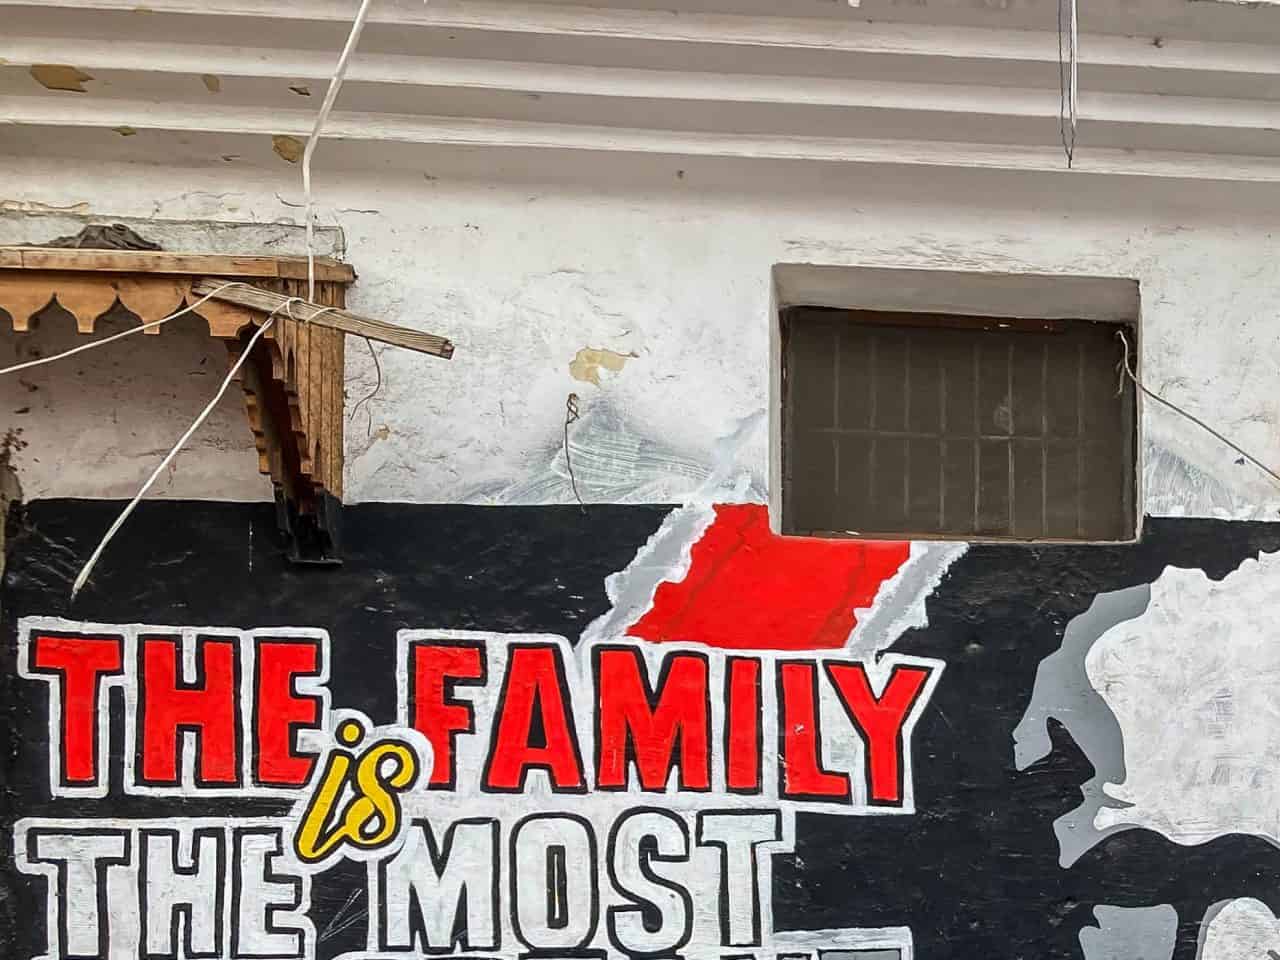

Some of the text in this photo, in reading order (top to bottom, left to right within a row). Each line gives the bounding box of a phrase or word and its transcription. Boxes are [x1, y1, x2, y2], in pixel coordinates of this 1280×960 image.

[28, 630, 938, 808] THE FAMILY
[293, 718, 420, 865] is
[27, 806, 783, 960] THE MOST
